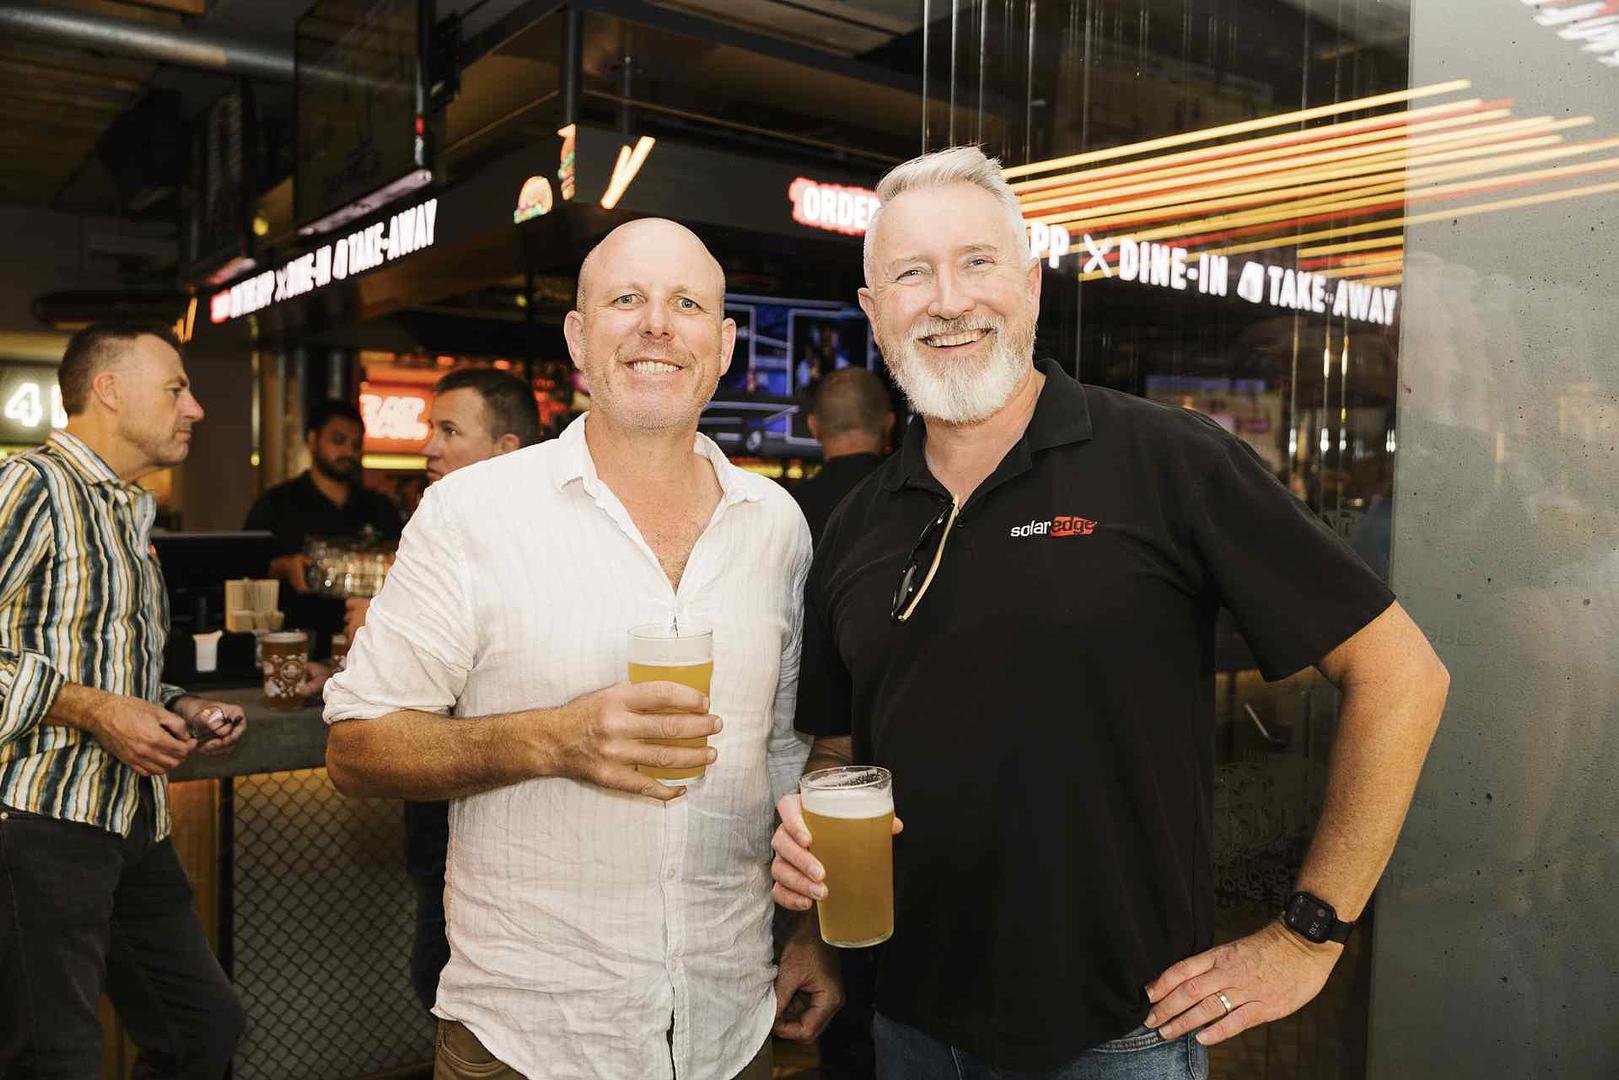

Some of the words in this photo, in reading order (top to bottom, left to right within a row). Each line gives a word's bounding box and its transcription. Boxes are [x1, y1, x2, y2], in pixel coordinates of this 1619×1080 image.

[1029, 221, 1070, 269] PP
[1119, 237, 1229, 297] DINE-IN
[1267, 265, 1398, 326] TAKE-AWAY
[1010, 515, 1097, 537] solaredge
